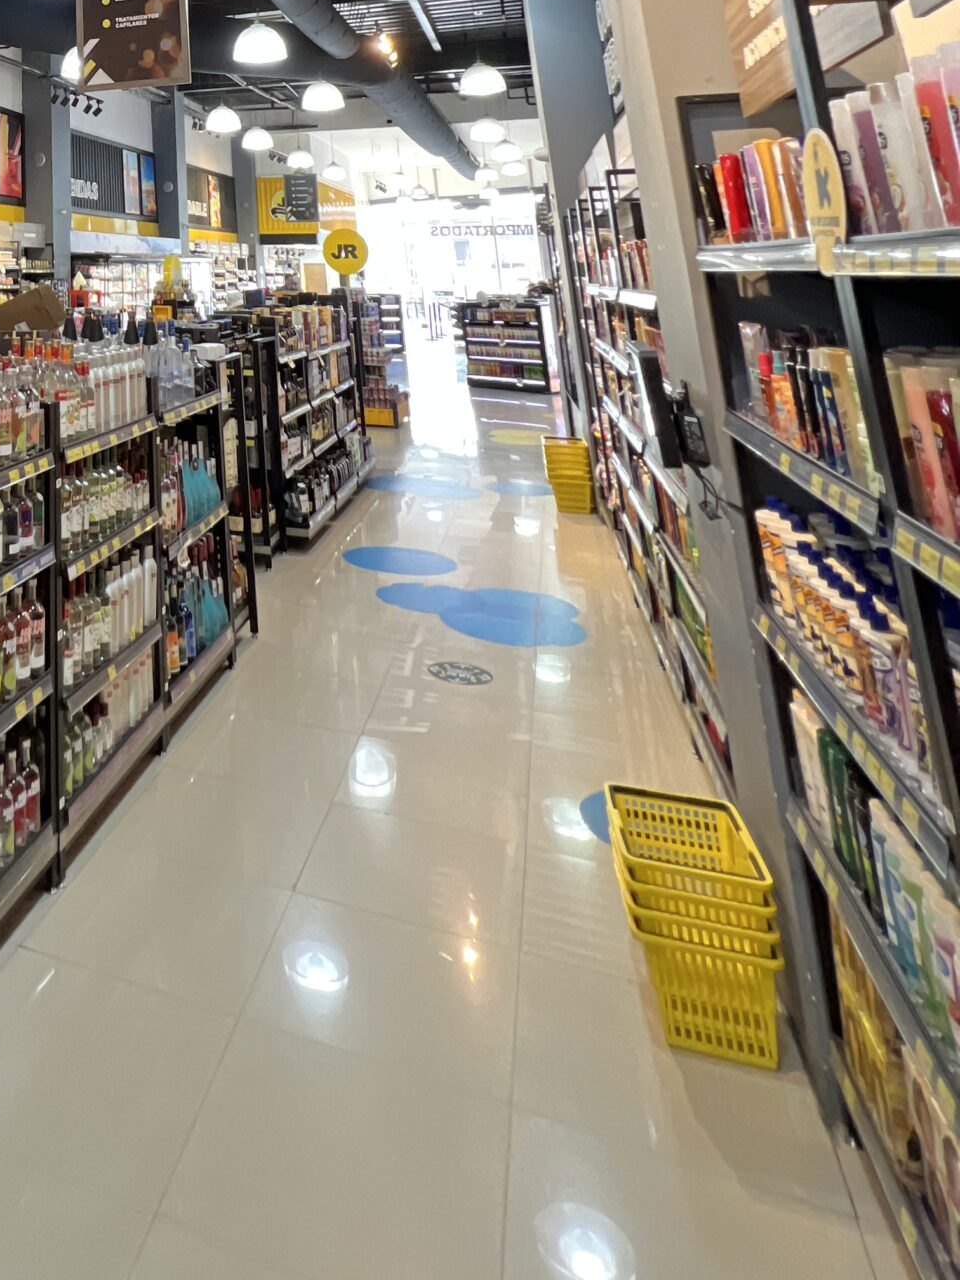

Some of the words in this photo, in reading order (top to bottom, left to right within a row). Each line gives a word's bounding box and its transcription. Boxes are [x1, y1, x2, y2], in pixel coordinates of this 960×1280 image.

[115, 13, 159, 23] TRATAMIENTOS
[115, 20, 147, 29] CAPILARES
[331, 244, 358, 259] JR
